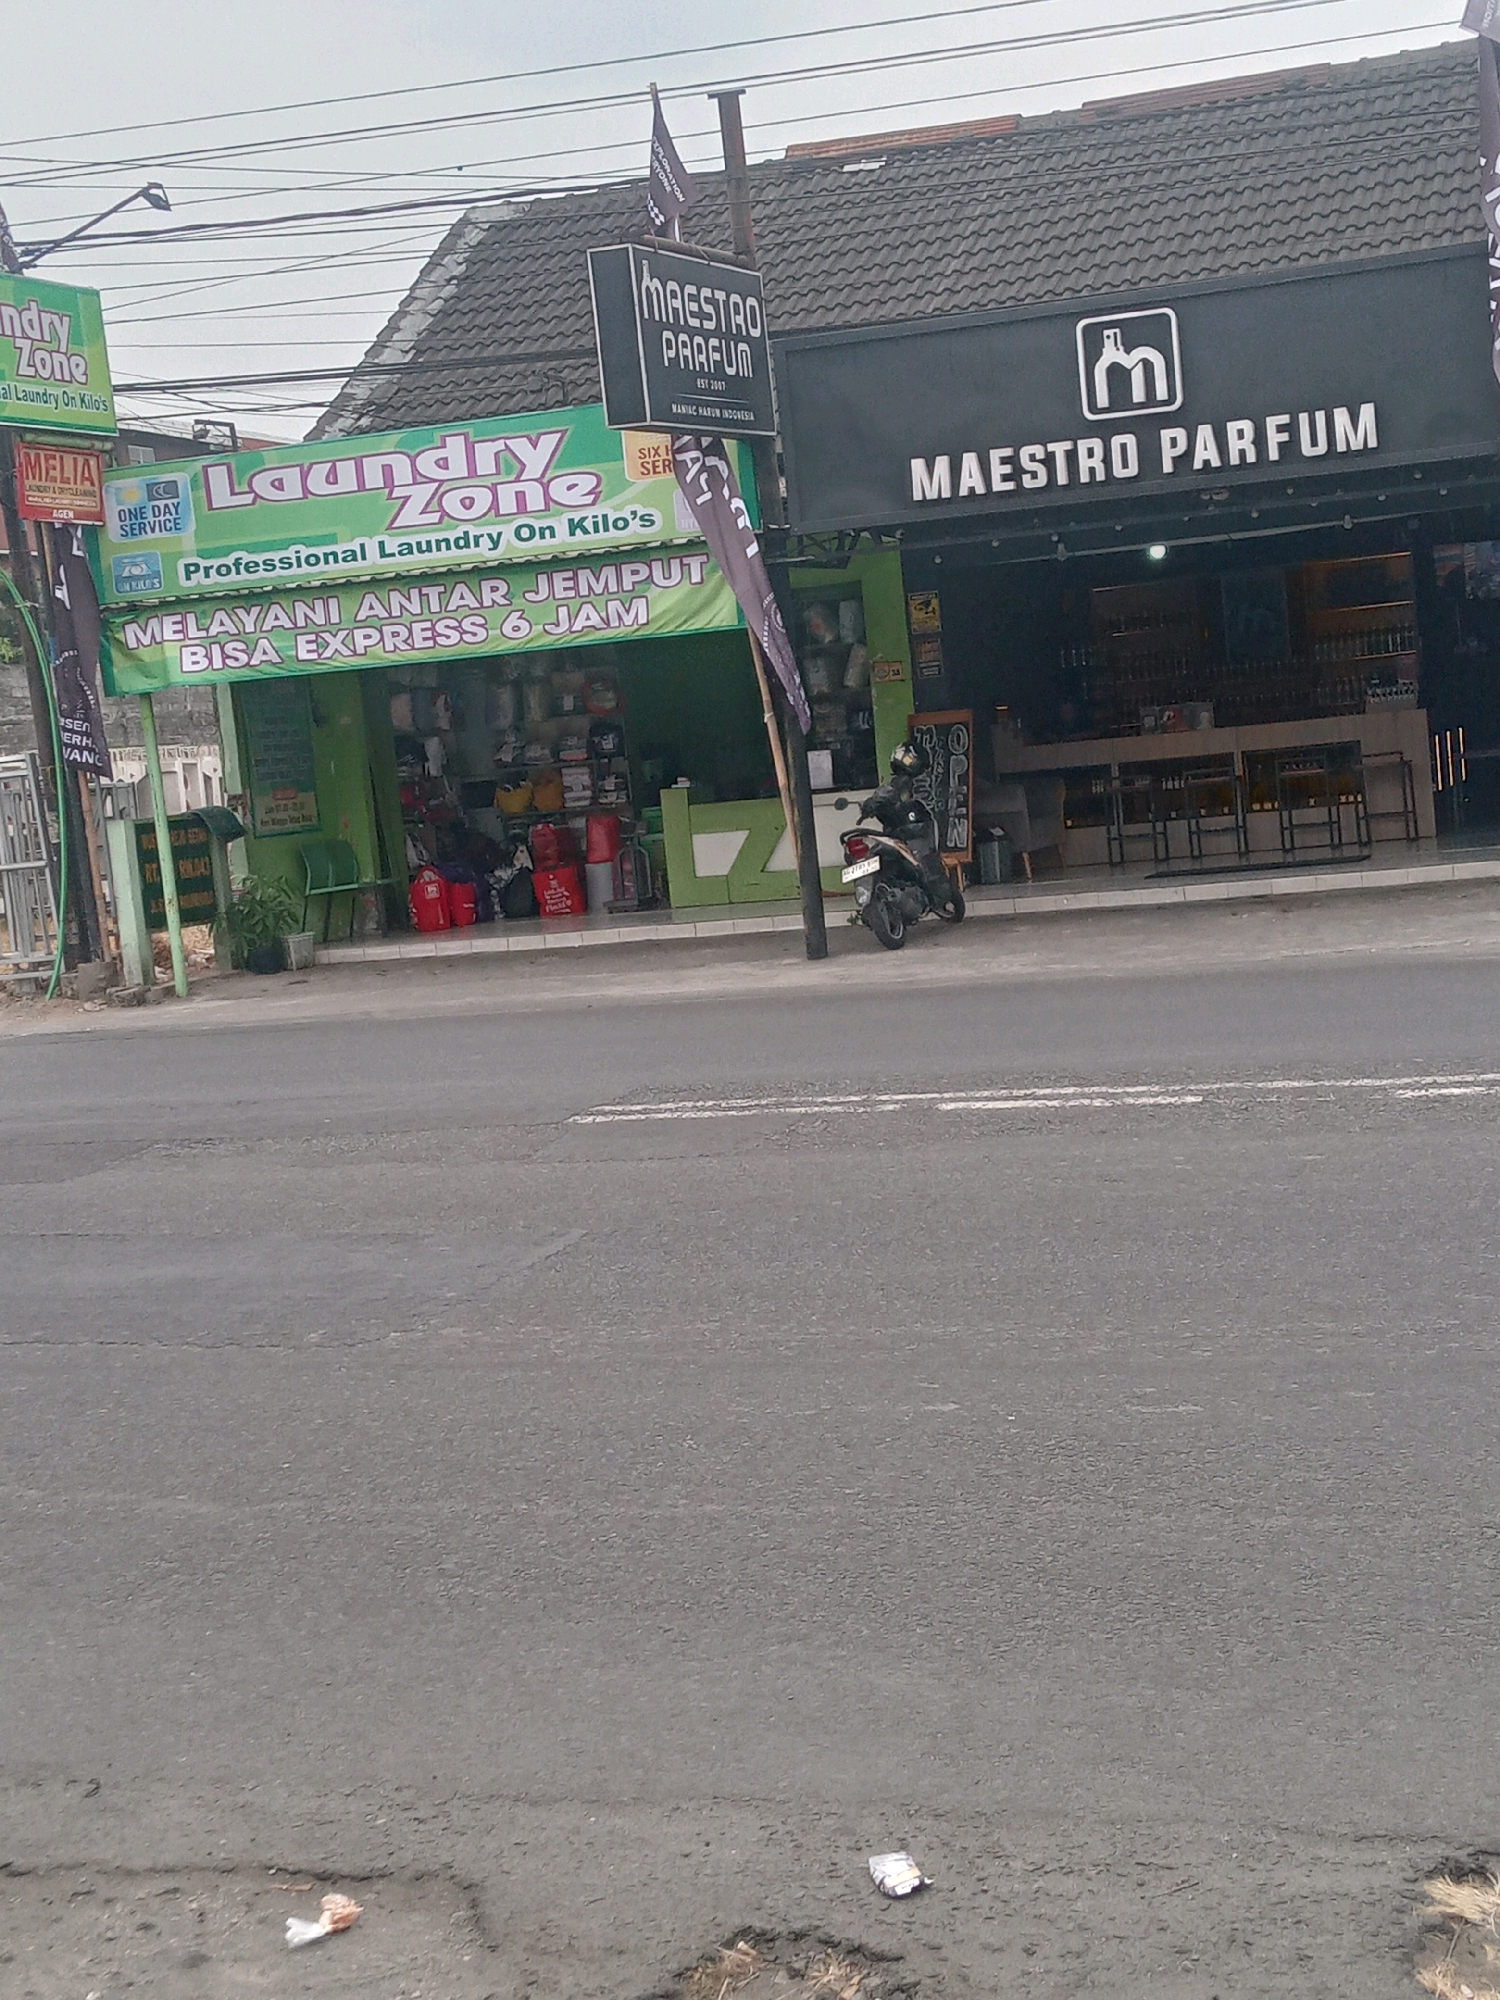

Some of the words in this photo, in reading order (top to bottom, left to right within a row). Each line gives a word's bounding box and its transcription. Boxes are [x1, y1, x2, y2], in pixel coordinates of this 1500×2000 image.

[641, 259, 762, 338] MAESTRO
[14, 337, 88, 386] Zone
[662, 330, 753, 378] PARFUM
[14, 384, 59, 410] Laundry
[62, 390, 77, 408] On
[23, 451, 96, 487] MELIA
[202, 428, 568, 512] Laundry
[638, 445, 662, 459] SIX
[910, 433, 1140, 501] MAESTRO
[1159, 402, 1379, 475] PARFUM
[52, 509, 74, 519] AGEN
[118, 505, 148, 523] ONE
[151, 502, 181, 518] DAY
[387, 472, 602, 531] Zone
[120, 517, 182, 538] SERVICE
[184, 542, 368, 582] Professional
[379, 525, 504, 559] Laundry
[514, 520, 557, 543] On
[568, 508, 657, 537] Kilo's
[123, 596, 341, 650] MELAYANI
[355, 578, 513, 623] ANTAR
[524, 553, 710, 604] JEMPUT
[180, 638, 283, 674] BISA
[296, 615, 488, 662] EXPRESS
[500, 610, 532, 641] 6
[543, 596, 650, 635] JAM
